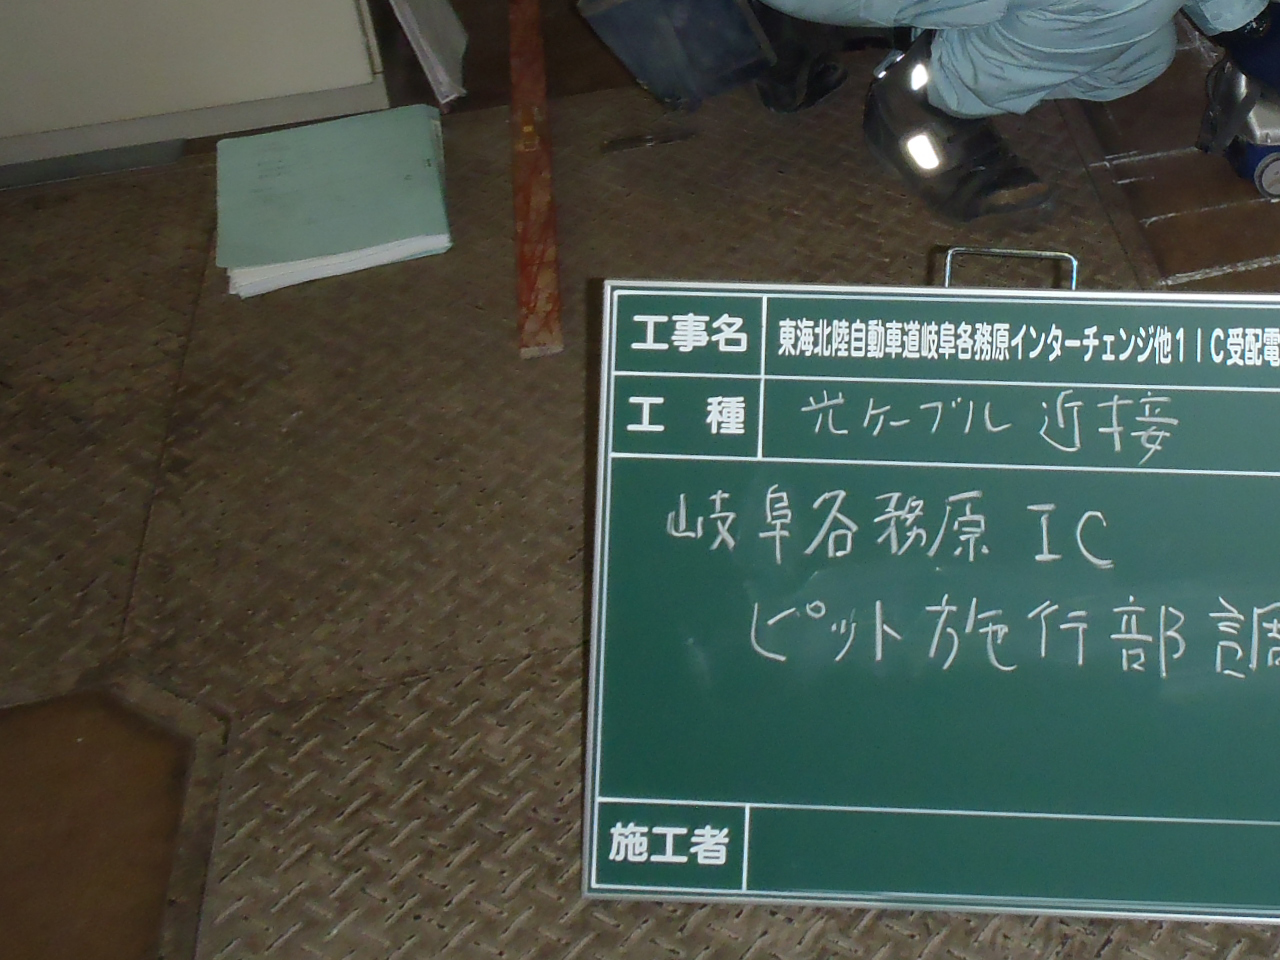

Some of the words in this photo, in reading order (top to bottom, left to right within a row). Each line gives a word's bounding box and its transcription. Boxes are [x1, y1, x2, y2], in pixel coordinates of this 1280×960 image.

[630, 313, 748, 353] 工事名
[608, 823, 730, 866] 施工者
